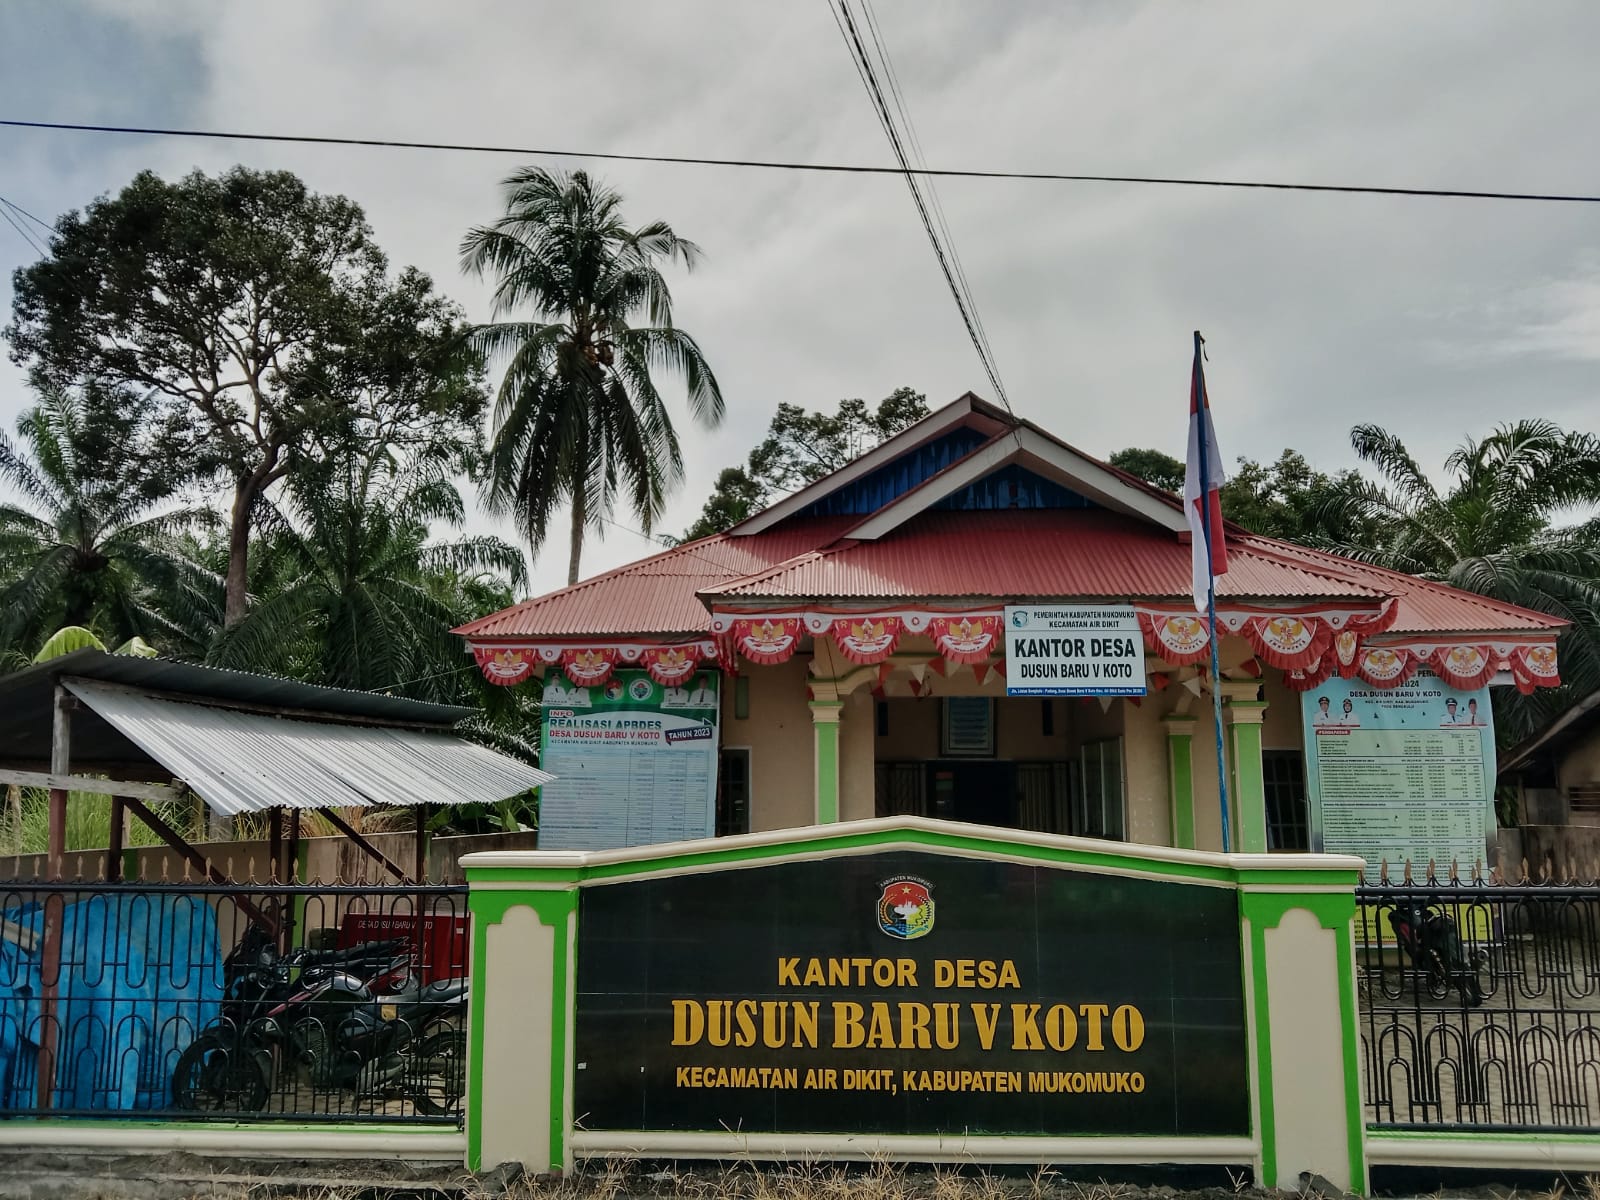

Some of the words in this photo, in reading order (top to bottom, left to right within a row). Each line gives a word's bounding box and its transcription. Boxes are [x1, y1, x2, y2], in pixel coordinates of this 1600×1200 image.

[1034, 611, 1068, 619] PEMERINTAH
[1069, 611, 1101, 619] KABUPATEN
[1102, 611, 1135, 619] MUKOMUKO
[1049, 620, 1088, 628] KECAMATAN
[1089, 620, 1101, 628] AIR
[1102, 620, 1120, 628] DIKIT
[1014, 638, 1086, 658] KANTOR
[1090, 638, 1137, 658] DESA
[1021, 663, 1058, 678] DUSUN
[1060, 663, 1089, 678] BARU
[1092, 663, 1100, 678] V
[1103, 663, 1132, 678] KOTO
[1399, 680, 1420, 688] 2024
[1349, 690, 1368, 698] DESA
[1369, 690, 1394, 698] DUSUN
[1395, 690, 1414, 698] BARU
[549, 718, 612, 730] REALISASI
[615, 720, 662, 731] APBDES
[549, 730, 572, 738] DESA
[573, 730, 602, 739] DUSUN
[604, 730, 628, 739] BARU
[629, 731, 636, 739] V
[637, 731, 660, 740] KOTO
[668, 729, 693, 740] TAHUN
[693, 727, 711, 738] 2023
[778, 957, 918, 988] KANTOR
[934, 959, 1021, 989] DESA
[671, 999, 820, 1049] DUSUN
[831, 1001, 962, 1050] BARU
[968, 1002, 1003, 1051] V
[1011, 1003, 1146, 1052] KOTO
[676, 1066, 798, 1088] KECAMATAN
[803, 1068, 839, 1090] AIR
[843, 1069, 897, 1097] DIKIT,
[902, 1070, 1023, 1093] KABUPATEN
[1028, 1072, 1146, 1094] MUKOMUKO
